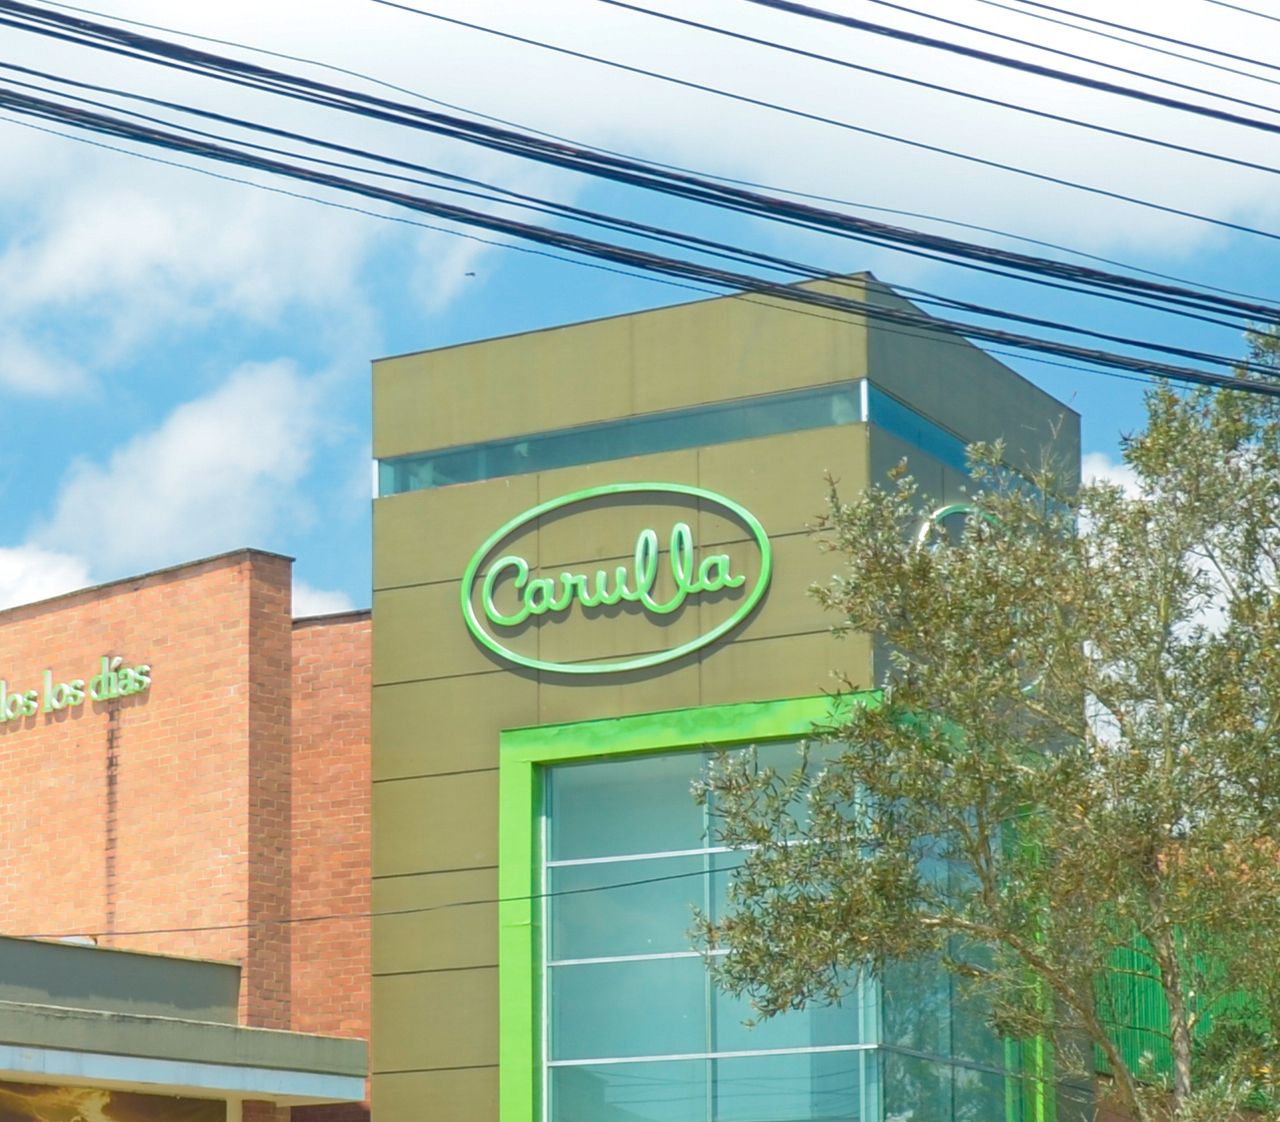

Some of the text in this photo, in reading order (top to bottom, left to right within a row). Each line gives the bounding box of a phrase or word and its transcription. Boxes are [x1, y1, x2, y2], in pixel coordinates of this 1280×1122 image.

[482, 522, 745, 626] Carulla
[41, 669, 86, 713] los
[89, 655, 152, 702] días
